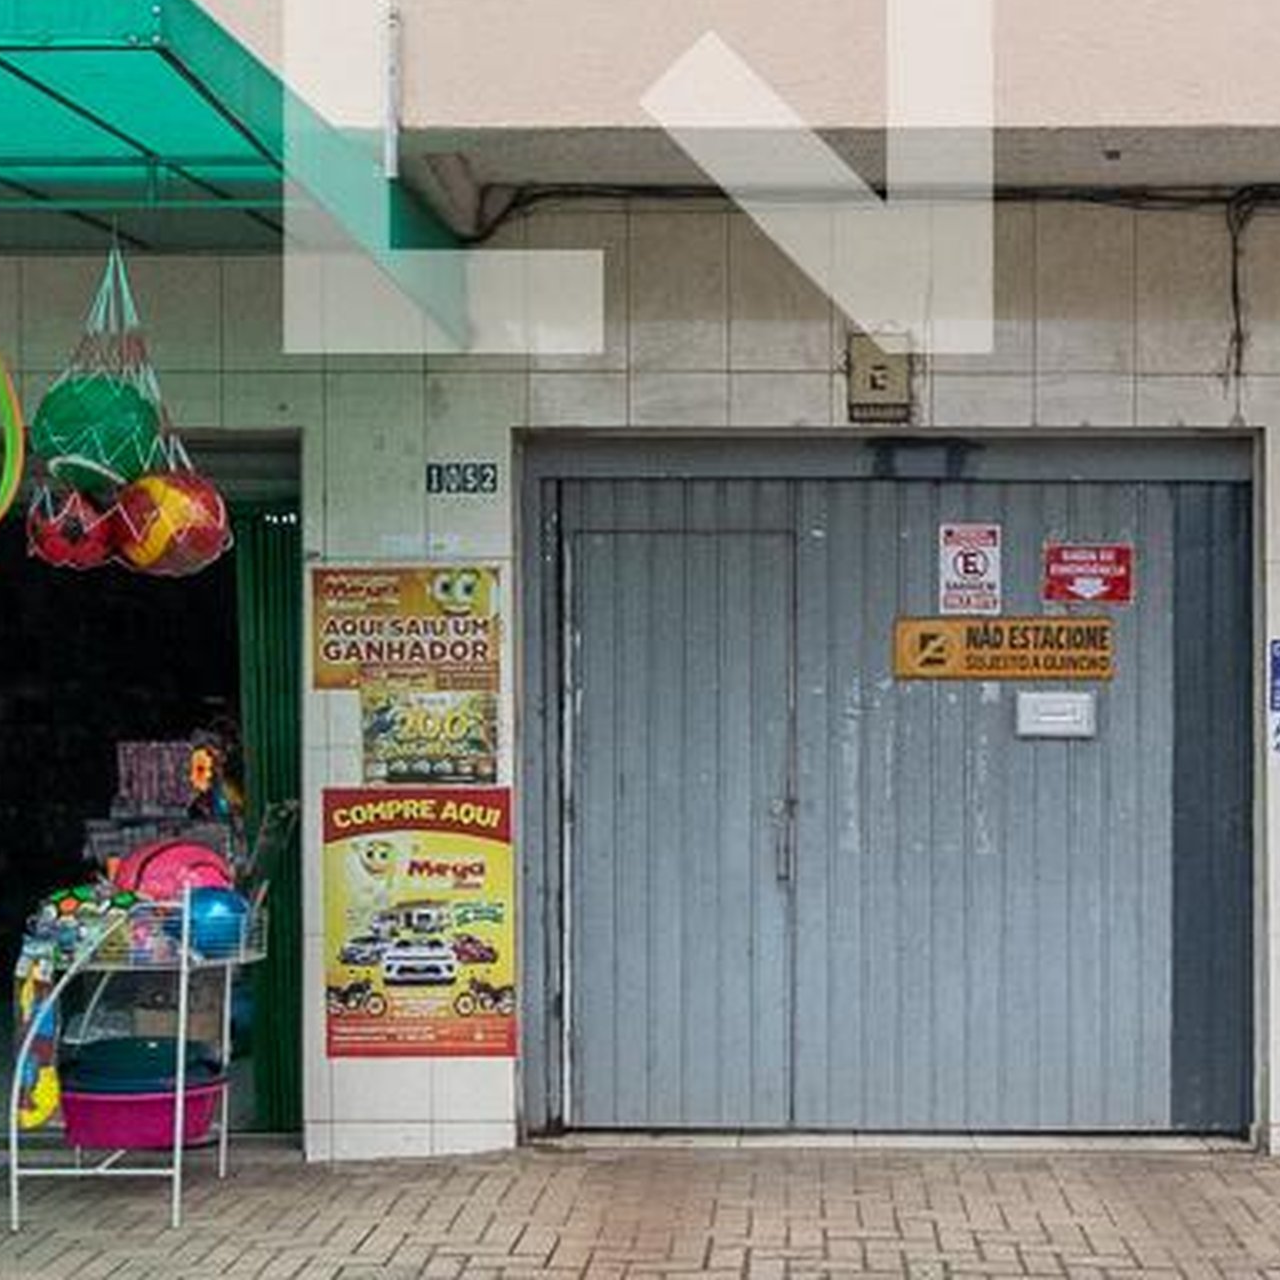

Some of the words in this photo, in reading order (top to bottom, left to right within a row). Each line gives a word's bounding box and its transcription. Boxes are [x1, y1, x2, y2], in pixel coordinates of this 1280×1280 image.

[1008, 626, 1111, 650] ESTACIONE
[322, 640, 489, 661] GANHADOR
[332, 799, 437, 828] COMPRE
[440, 800, 502, 828] AQUI
